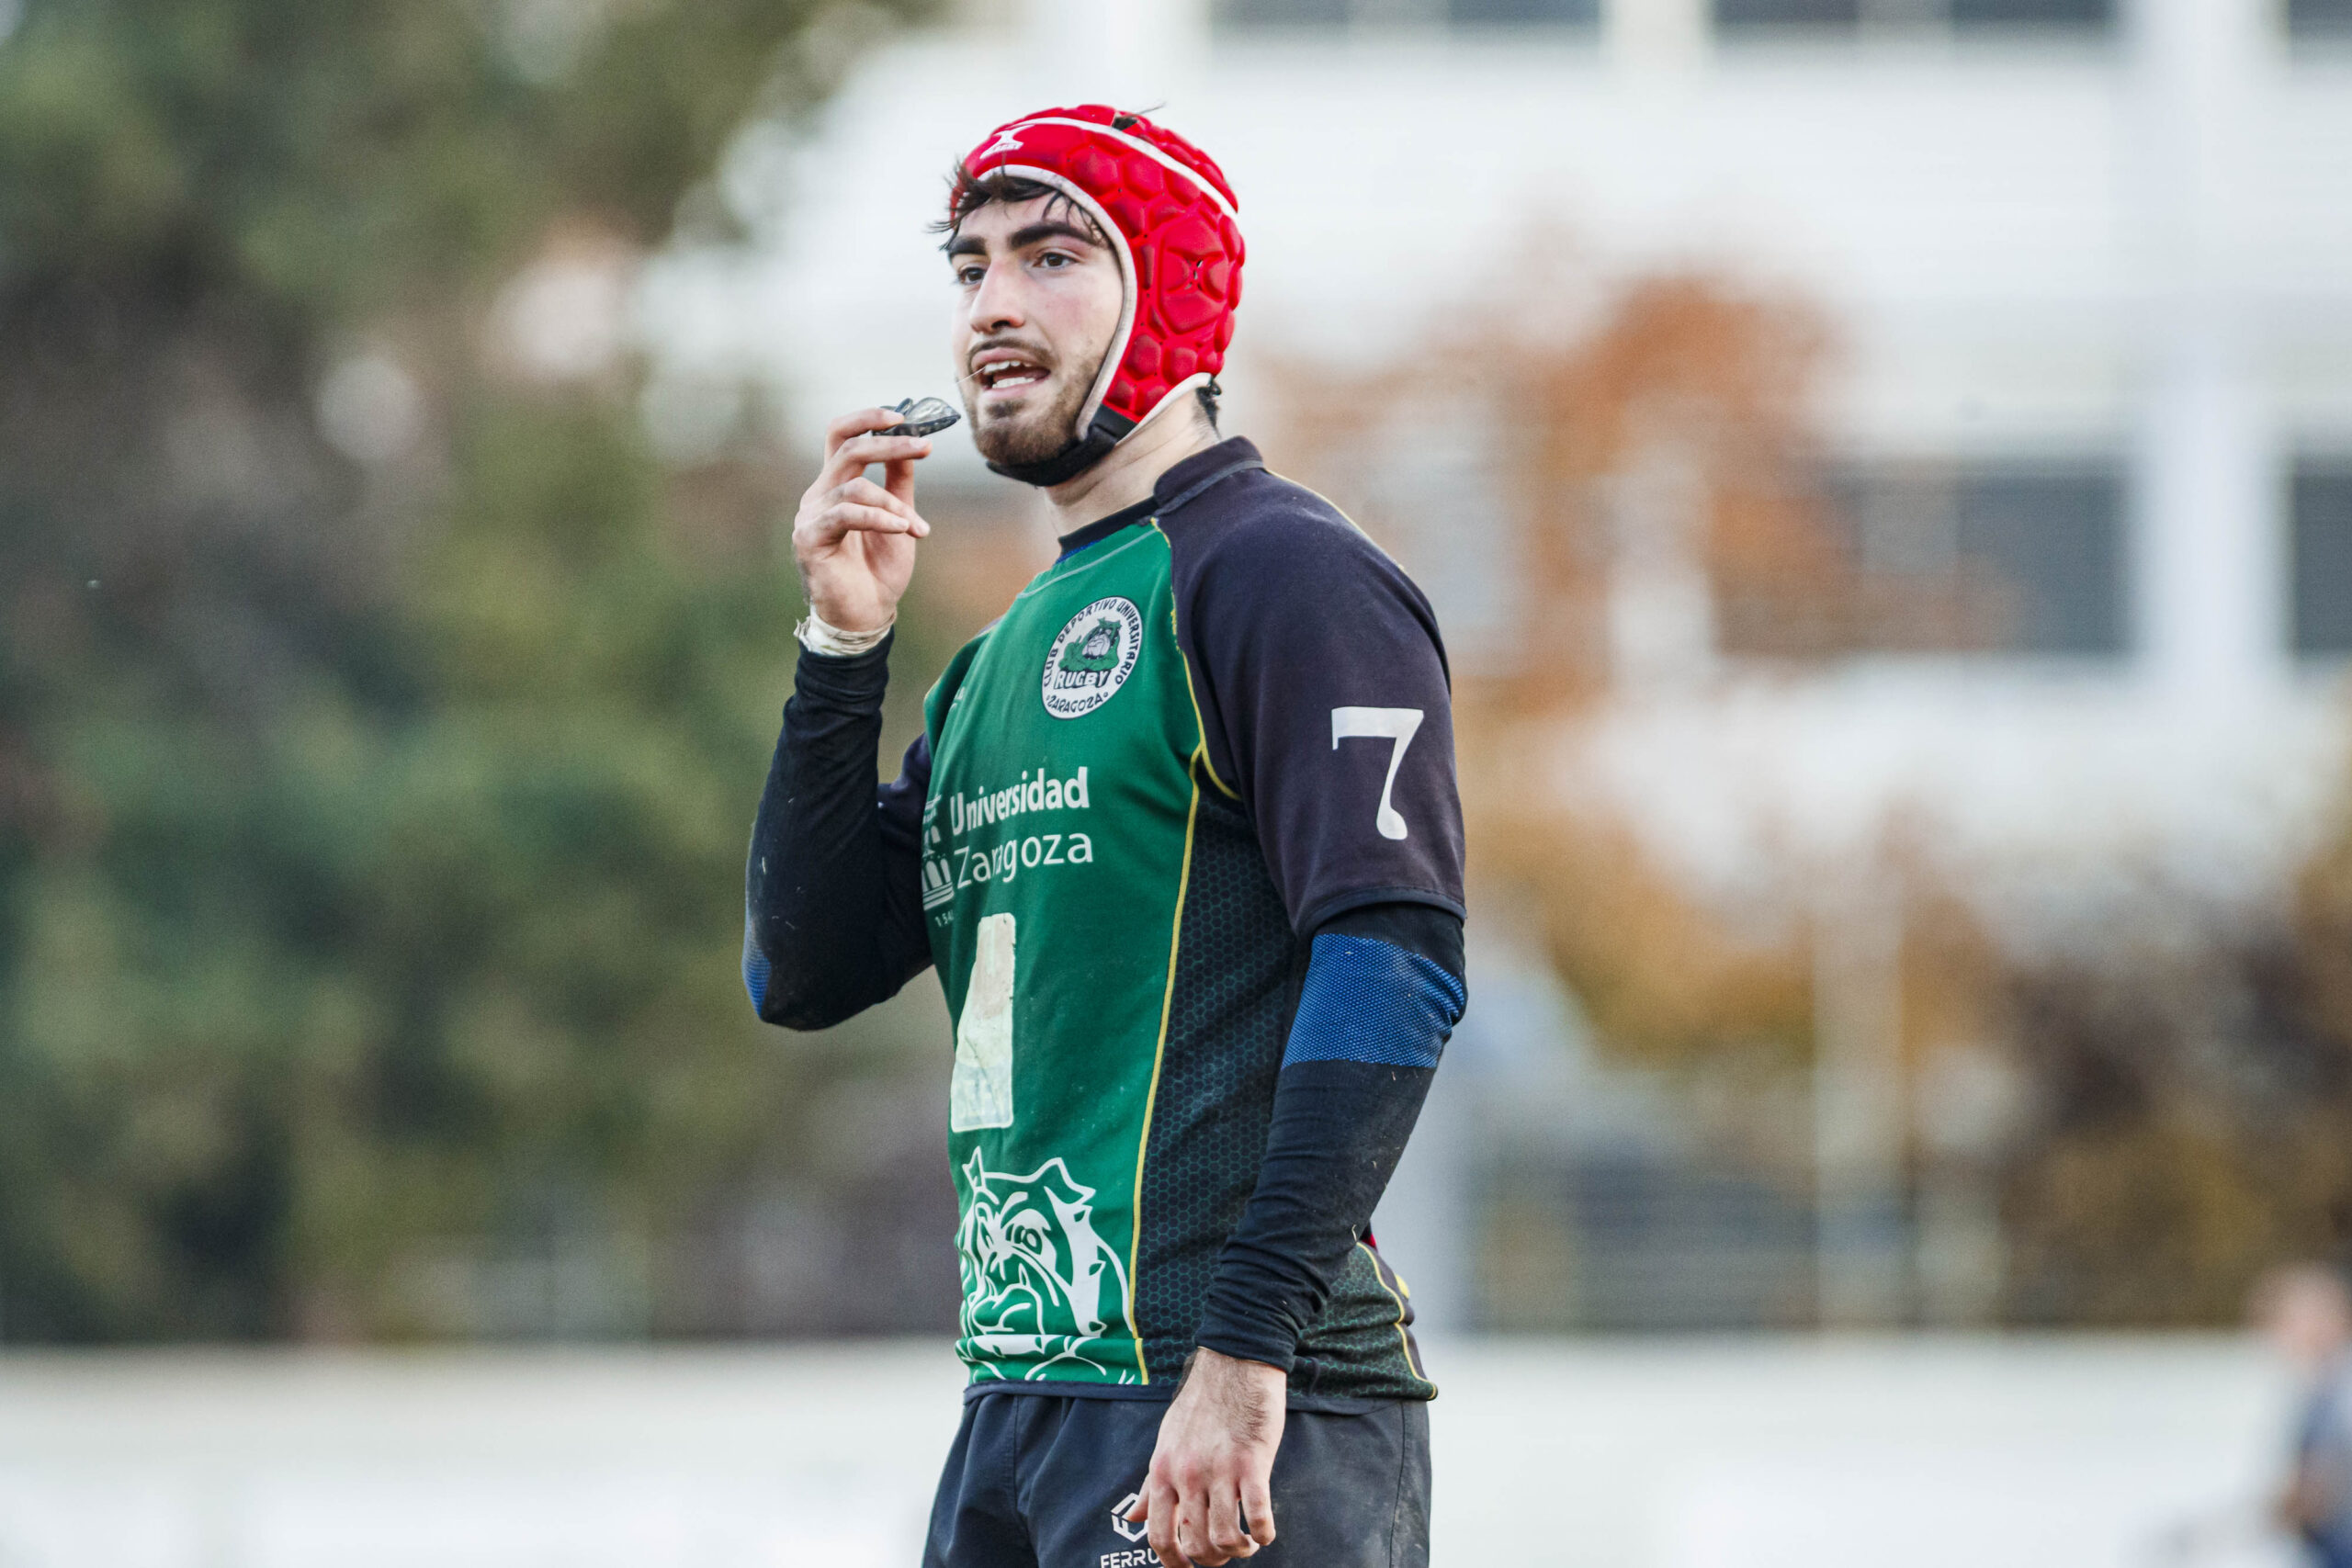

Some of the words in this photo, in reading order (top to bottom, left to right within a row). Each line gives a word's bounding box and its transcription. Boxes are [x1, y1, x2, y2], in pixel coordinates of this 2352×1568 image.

[1044, 648, 1058, 687] CLUB
[1057, 599, 1117, 643] DEPORTIVO
[1115, 601, 1140, 684] UNIVERSITARIO
[1047, 693, 1102, 713] ZARAGOZA
[1054, 671, 1111, 689] RUGBY
[950, 766, 1090, 836] Universidad
[1331, 706, 1424, 840] 7
[954, 832, 1093, 889] Zaragoza
